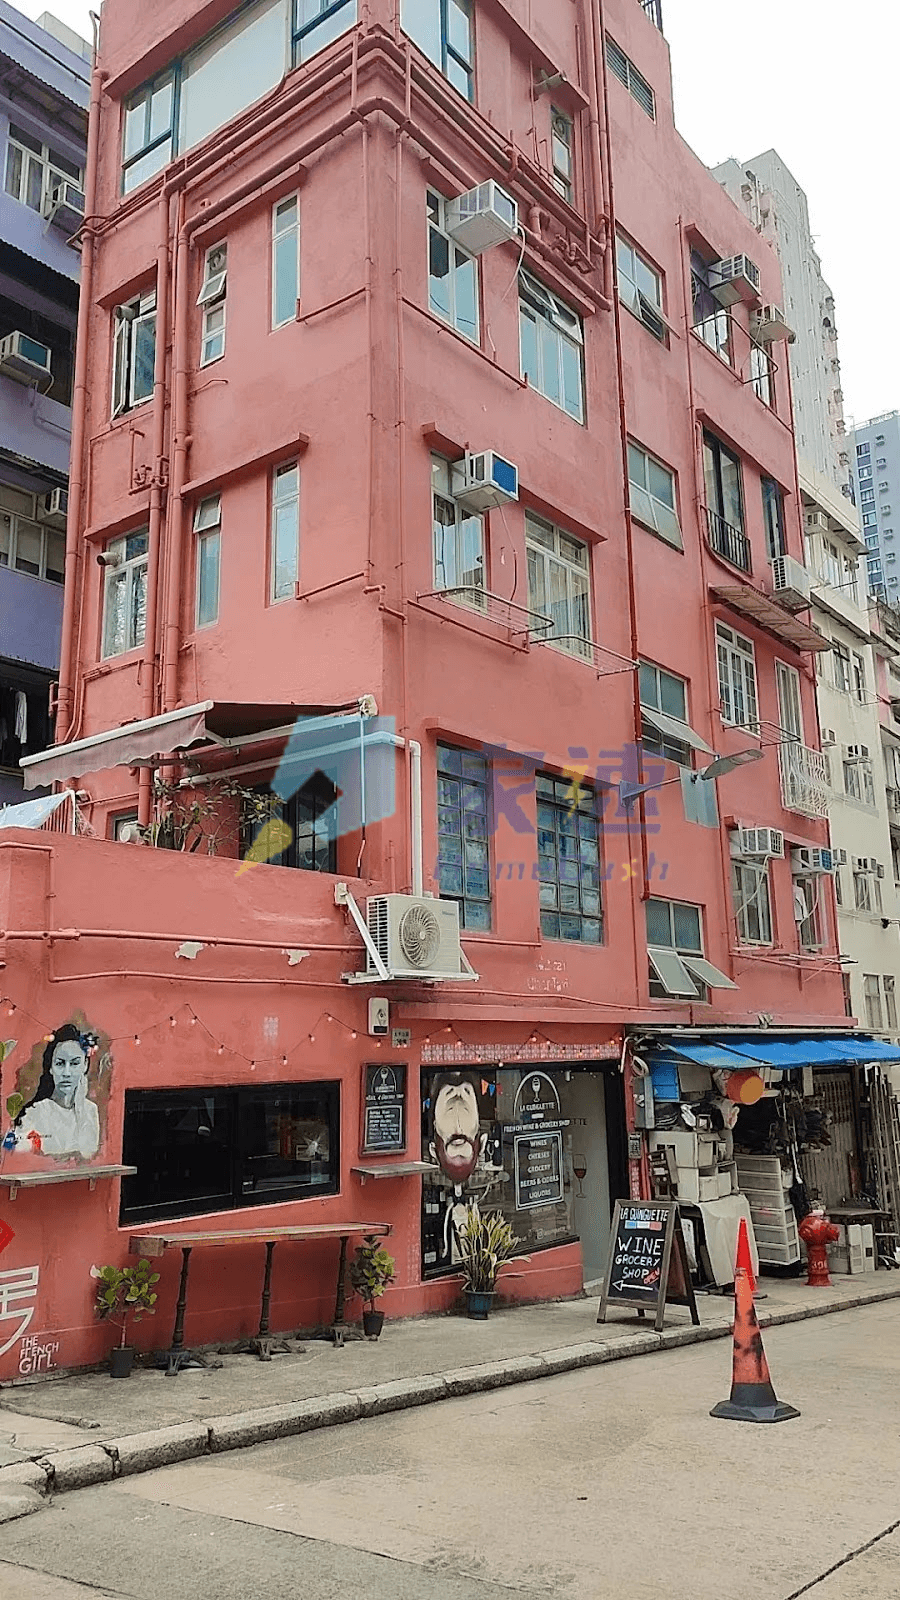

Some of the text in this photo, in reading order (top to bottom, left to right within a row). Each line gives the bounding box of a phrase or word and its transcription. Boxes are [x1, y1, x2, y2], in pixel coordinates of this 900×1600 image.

[530, 1139, 547, 1147] WINES
[528, 1151, 550, 1160] CHEESES
[527, 1164, 551, 1173] GROCERY
[520, 1178, 536, 1188] BEERS
[529, 1189, 551, 1199] LIQUORS
[620, 1208, 629, 1220] LA
[618, 1236, 665, 1255] WINE
[615, 1254, 660, 1266] GROCERY
[622, 1266, 649, 1279] SHOP
[22, 1336, 38, 1348] THE
